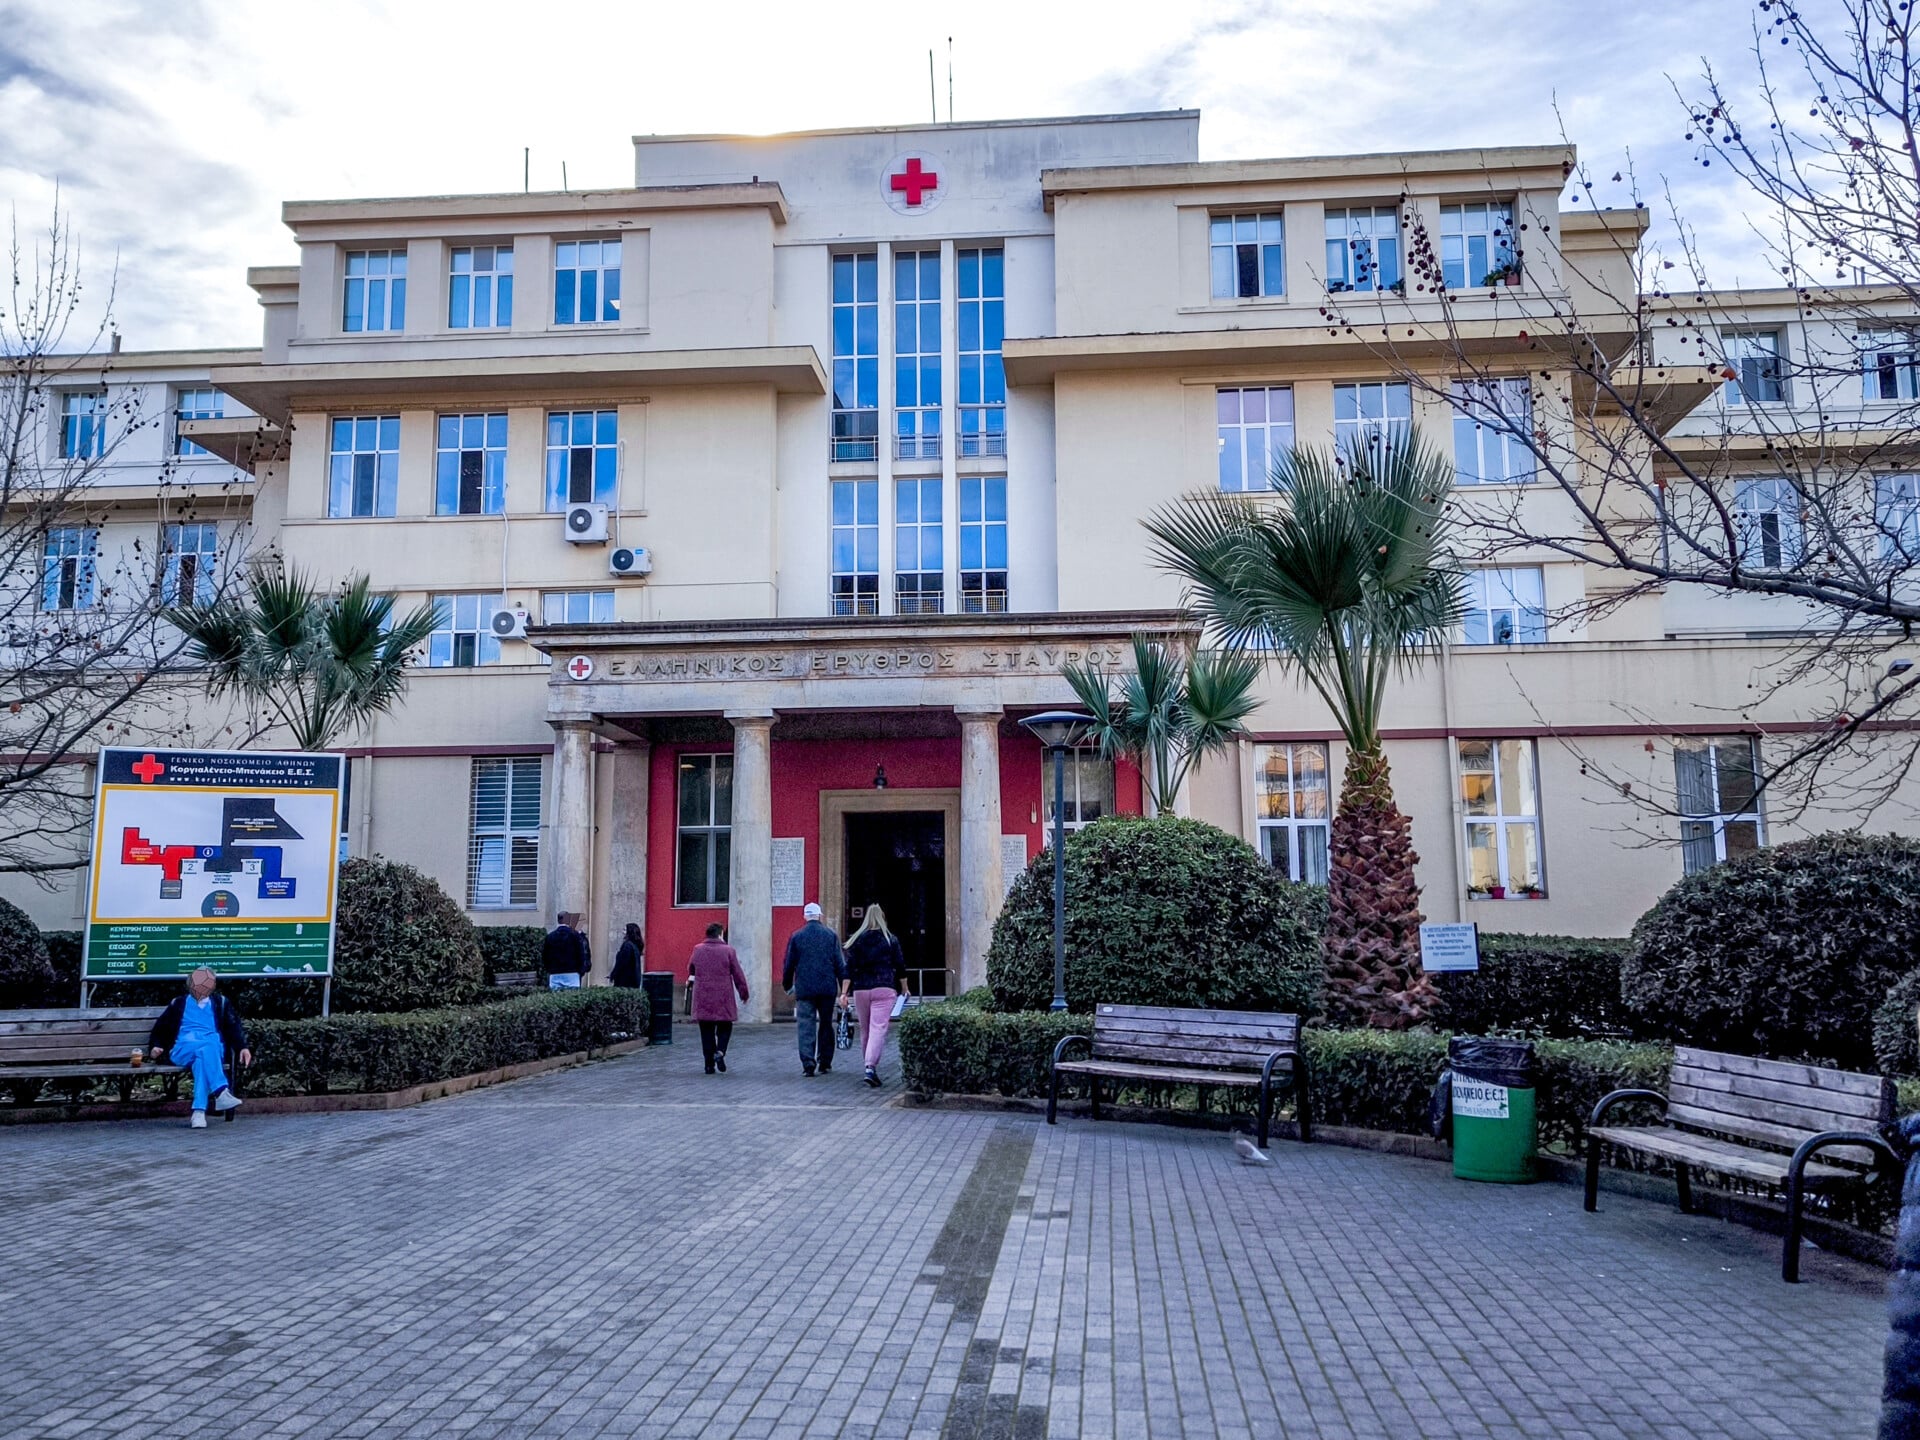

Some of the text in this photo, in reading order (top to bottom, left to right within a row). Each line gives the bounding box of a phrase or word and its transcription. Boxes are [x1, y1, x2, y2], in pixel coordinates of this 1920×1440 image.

[610, 650, 1122, 675] ΕΛΛΗΝΙΚΟΣ ΕΡΥΘΡΟΣ ΣΤΑΥΡΟΣ
[170, 765, 314, 776] Κοργιαλένειο-Μπενάκειο Ε.Ε.Σ.
[138, 943, 148, 956] 2
[137, 961, 147, 974] 3
